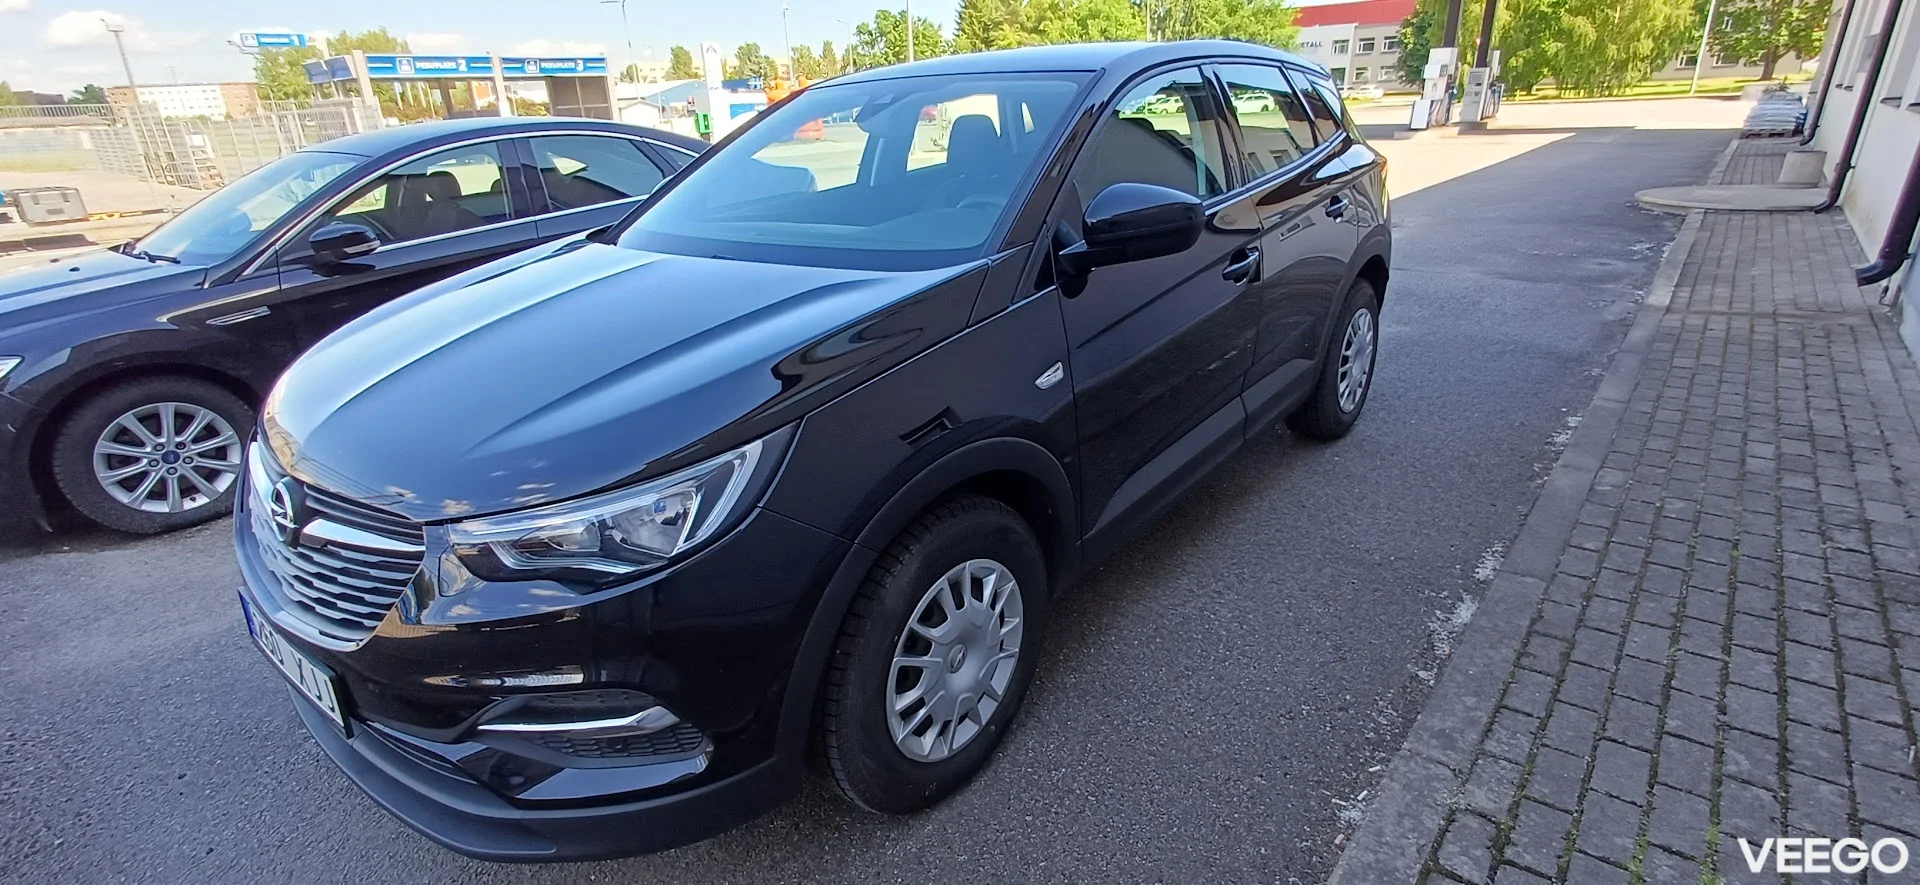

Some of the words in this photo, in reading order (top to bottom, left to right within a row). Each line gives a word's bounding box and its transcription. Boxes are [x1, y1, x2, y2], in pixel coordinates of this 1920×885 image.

[457, 59, 468, 72] 2
[576, 60, 584, 72] 3
[290, 650, 336, 714] XJJ
